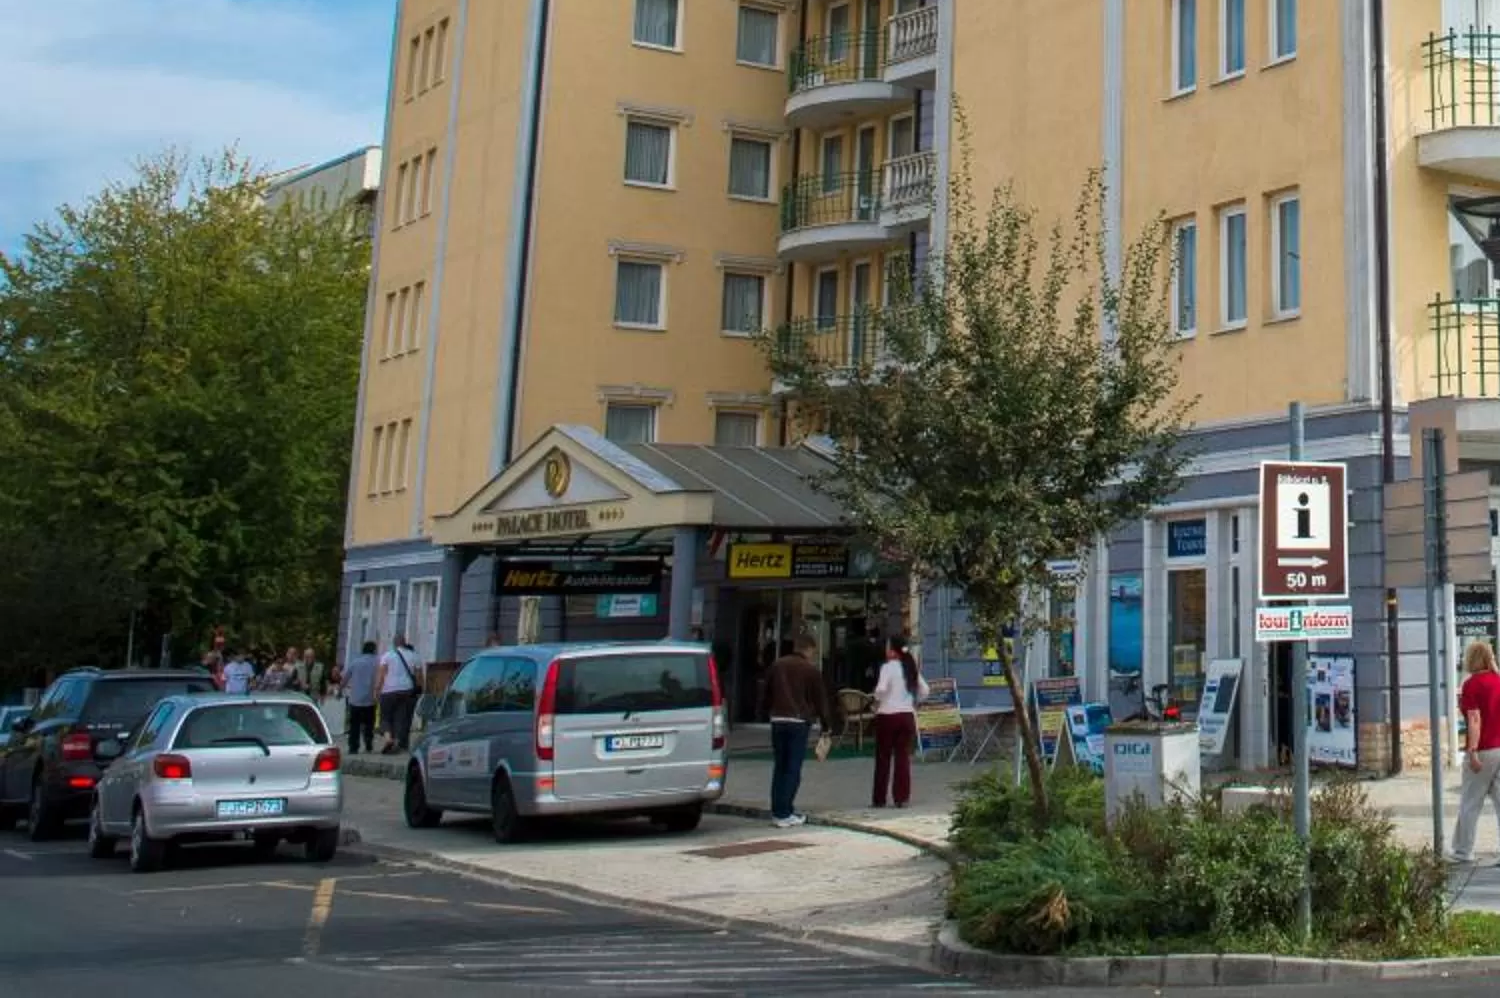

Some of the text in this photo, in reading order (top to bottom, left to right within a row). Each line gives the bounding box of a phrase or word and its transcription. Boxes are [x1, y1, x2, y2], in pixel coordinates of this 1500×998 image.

[497, 509, 592, 537] PALACE HOTEL
[736, 551, 785, 569] Hertz
[503, 569, 560, 587] Hertz
[1286, 572, 1327, 588] 50 m
[1258, 609, 1349, 631] tourinform
